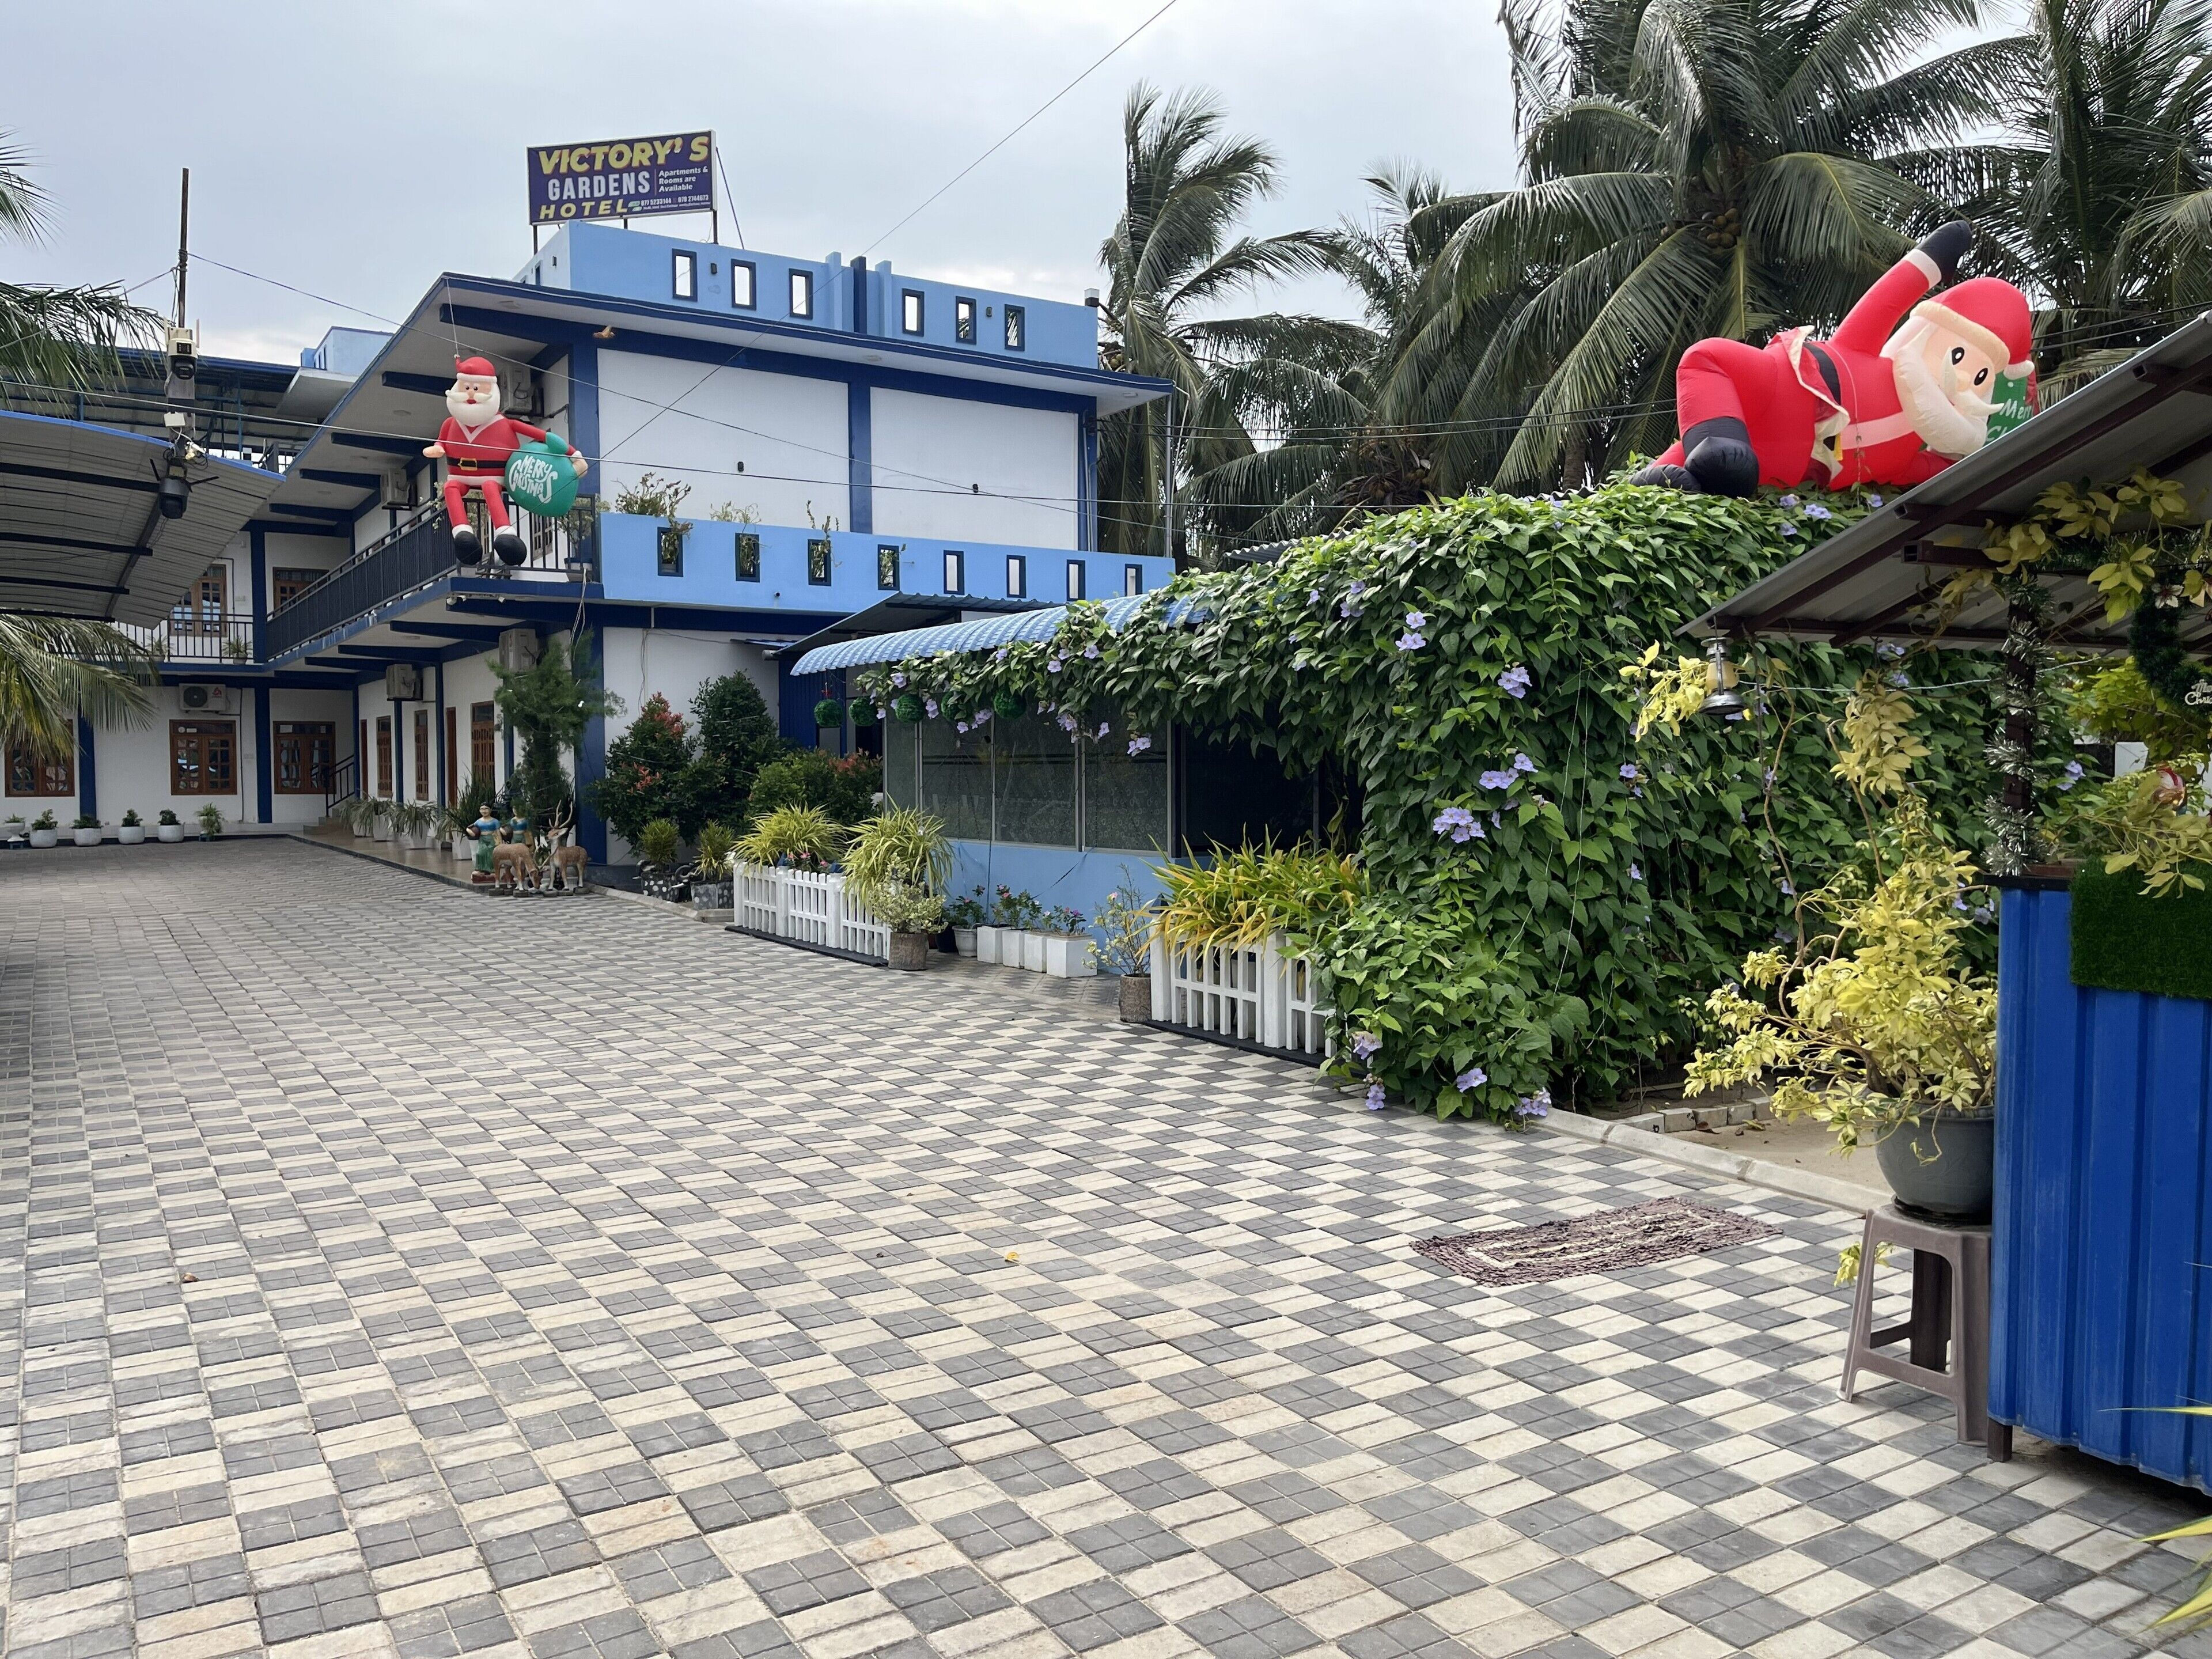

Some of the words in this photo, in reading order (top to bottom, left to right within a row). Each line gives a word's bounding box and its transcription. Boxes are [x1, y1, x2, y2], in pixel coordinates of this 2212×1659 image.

[658, 167, 701, 178] Apartments
[548, 171, 650, 200] GARDENS
[658, 184, 693, 192] Available
[539, 199, 628, 219] HOTEL
[519, 454, 552, 483] MERRY
[509, 459, 558, 503] CHRISTMAS
